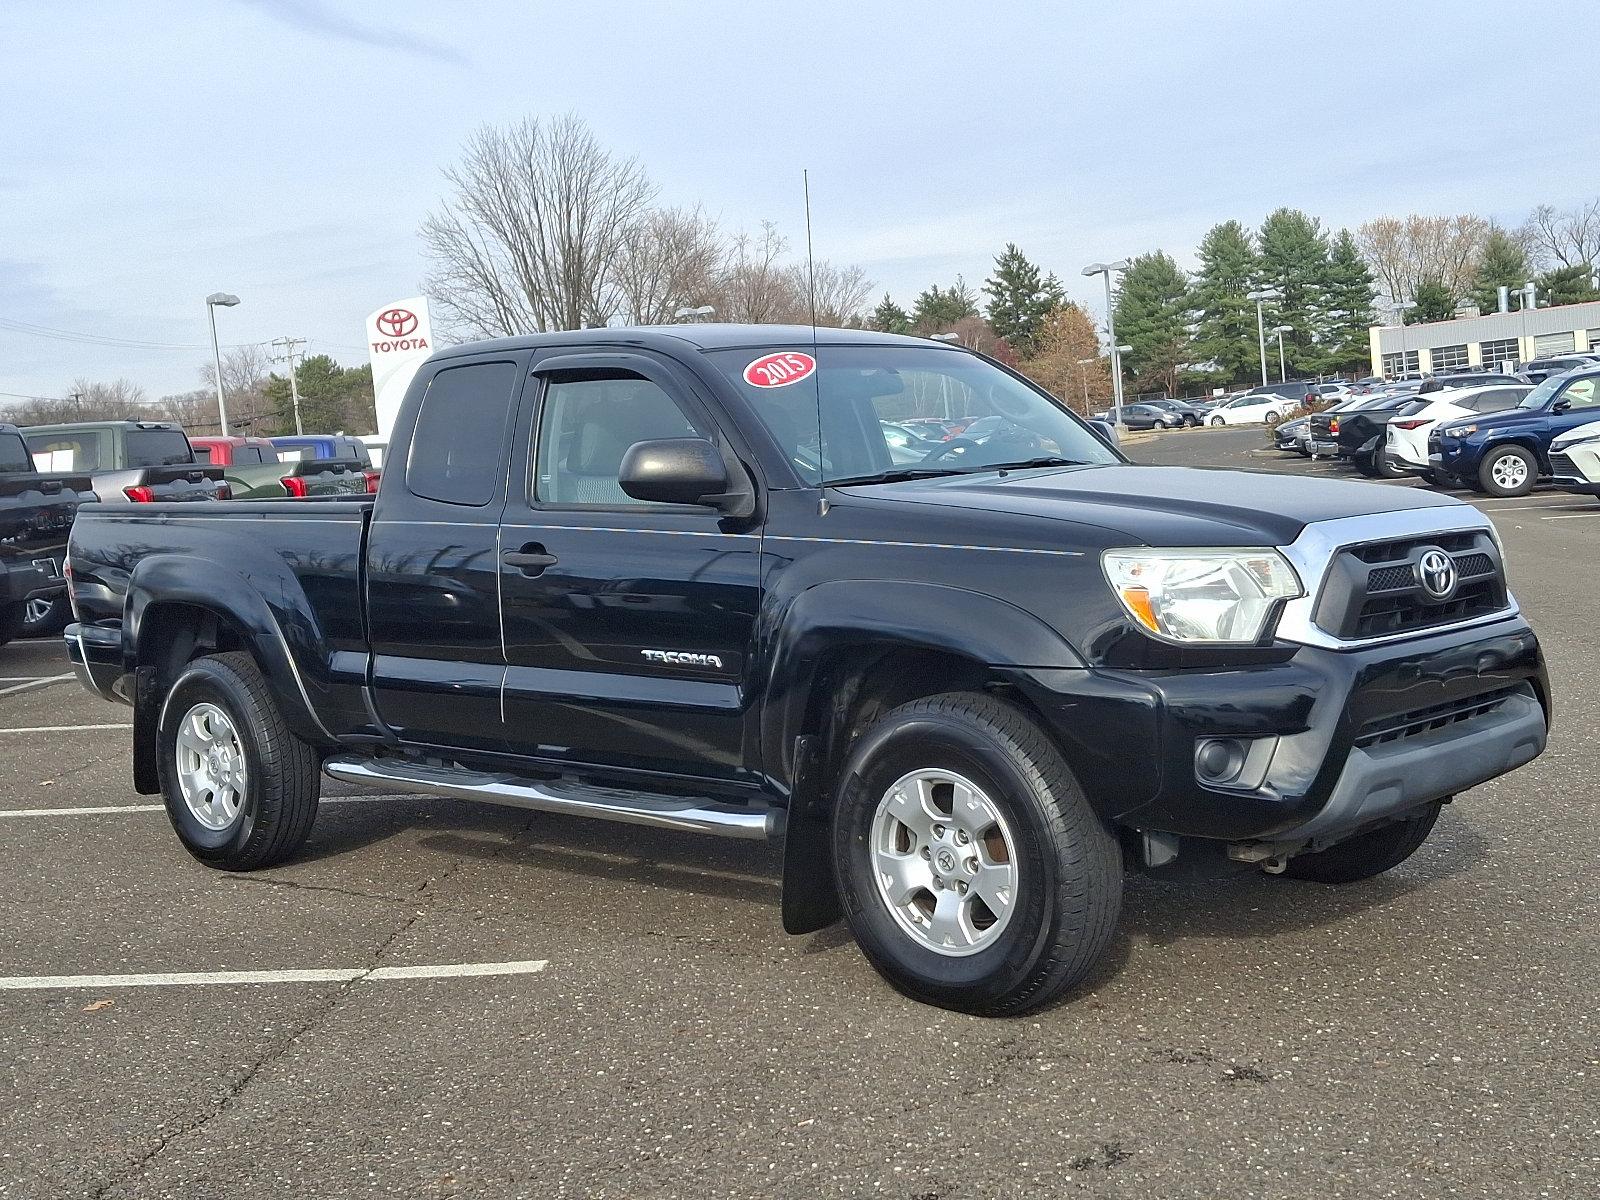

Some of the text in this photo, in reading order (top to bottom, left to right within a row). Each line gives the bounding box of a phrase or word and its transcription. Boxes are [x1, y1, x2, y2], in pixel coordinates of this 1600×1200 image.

[372, 338, 428, 353] TOYOTA
[757, 355, 805, 385] 2015
[641, 650, 722, 668] TACOMA
